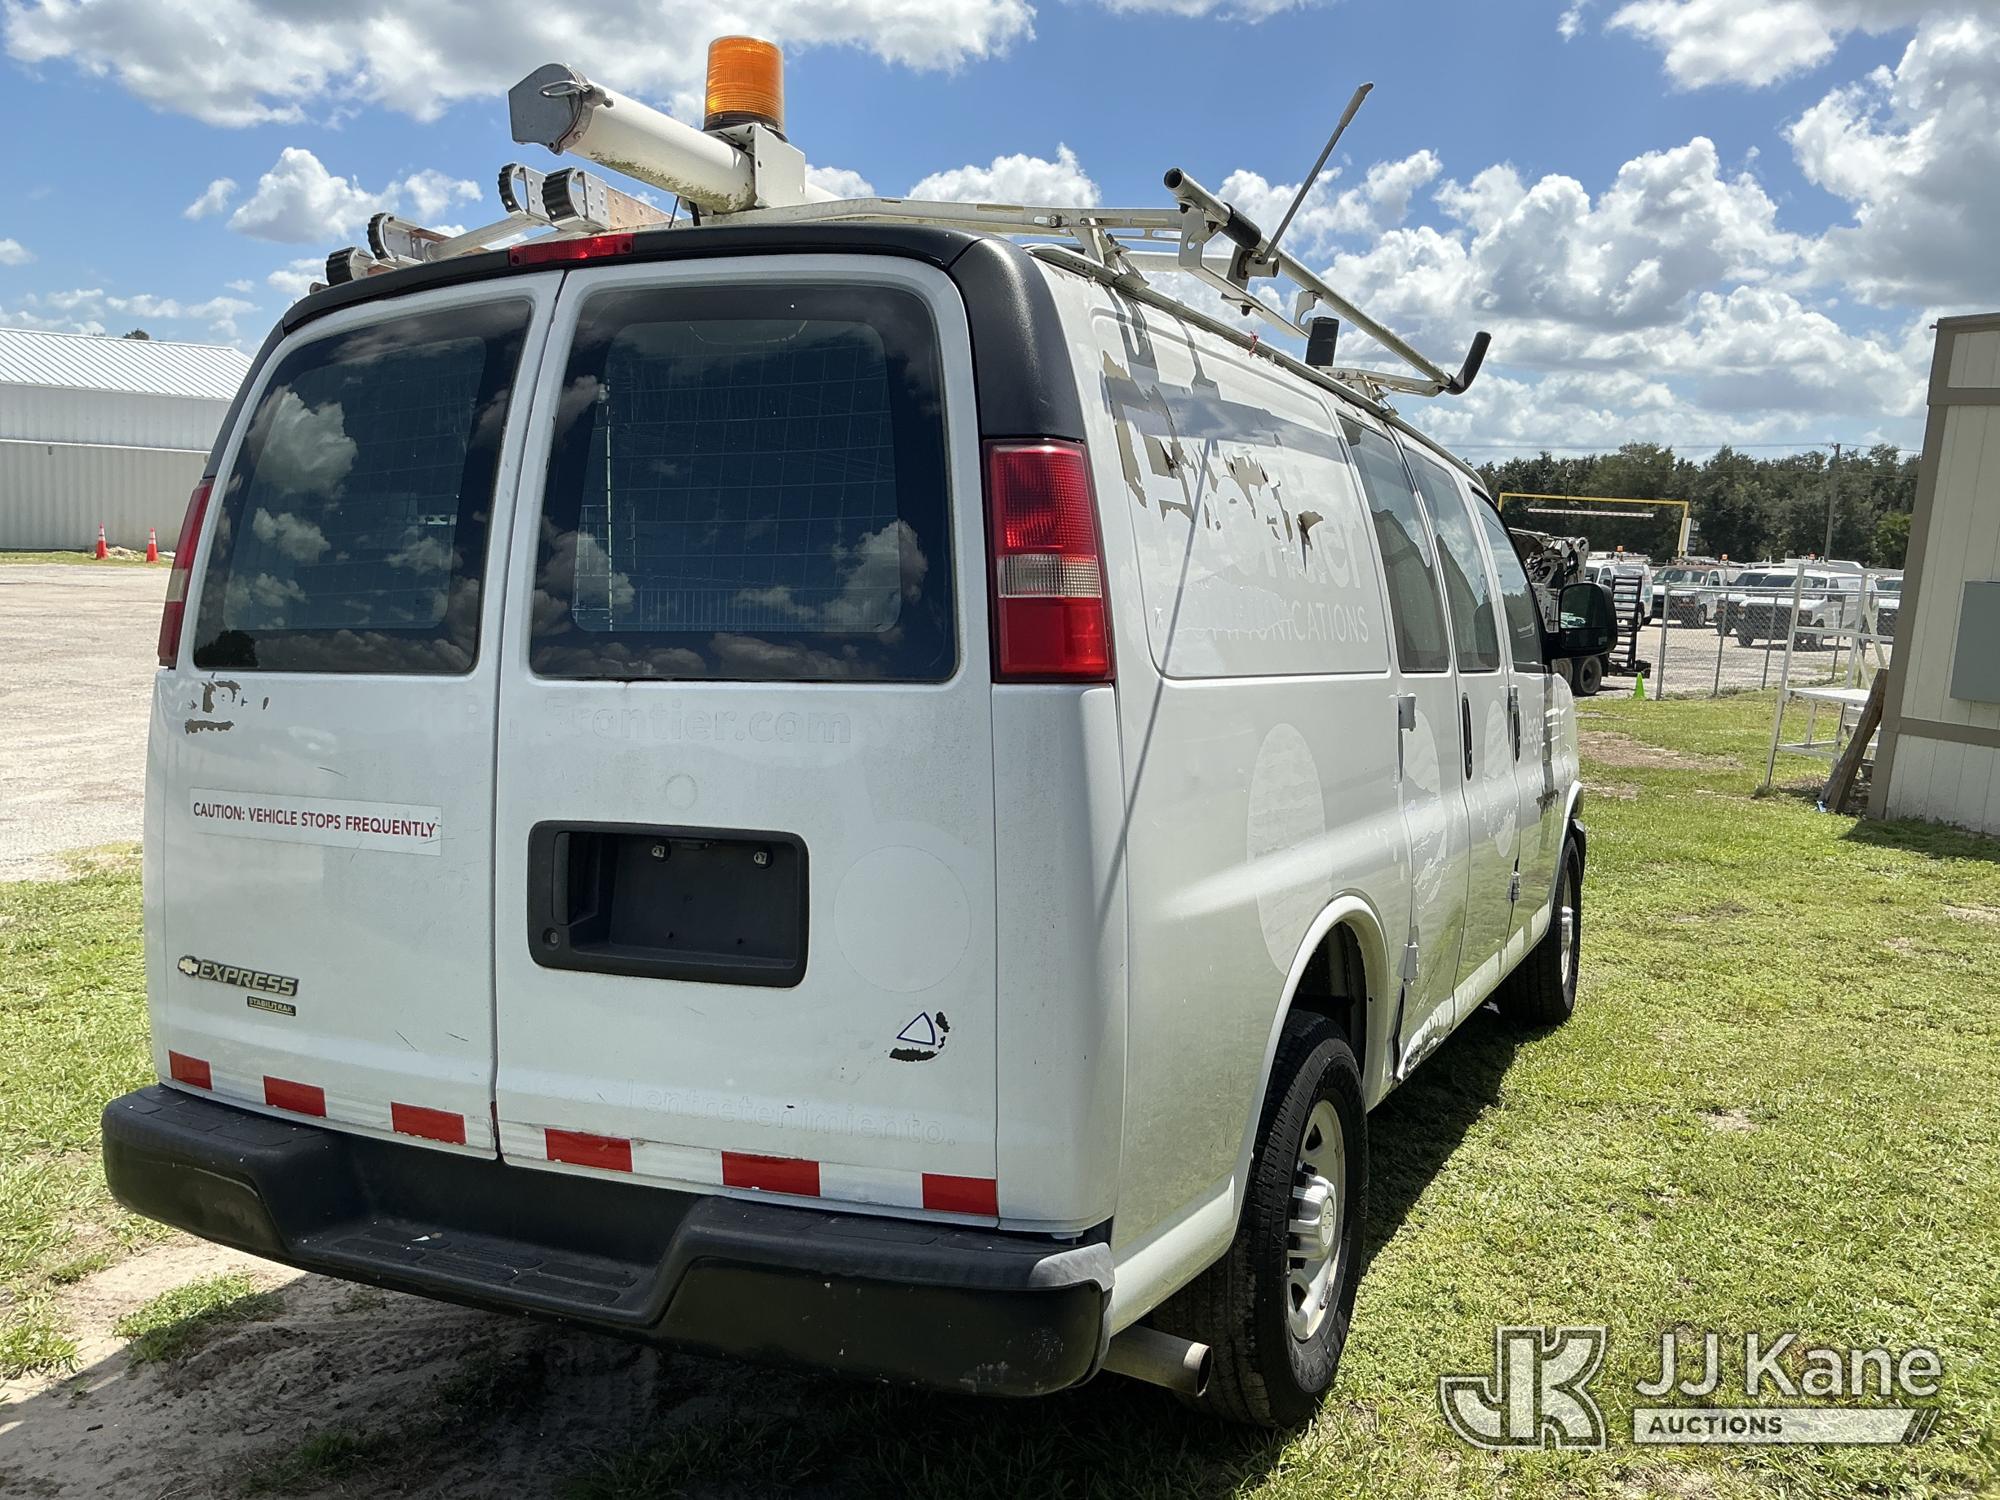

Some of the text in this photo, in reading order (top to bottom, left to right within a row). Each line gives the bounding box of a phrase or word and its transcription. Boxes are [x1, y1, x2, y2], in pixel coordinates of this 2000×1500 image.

[193, 802, 437, 838] CAUTION: VEHICLE STOPS FREQUENTLY
[197, 961, 297, 996] EXPRESS
